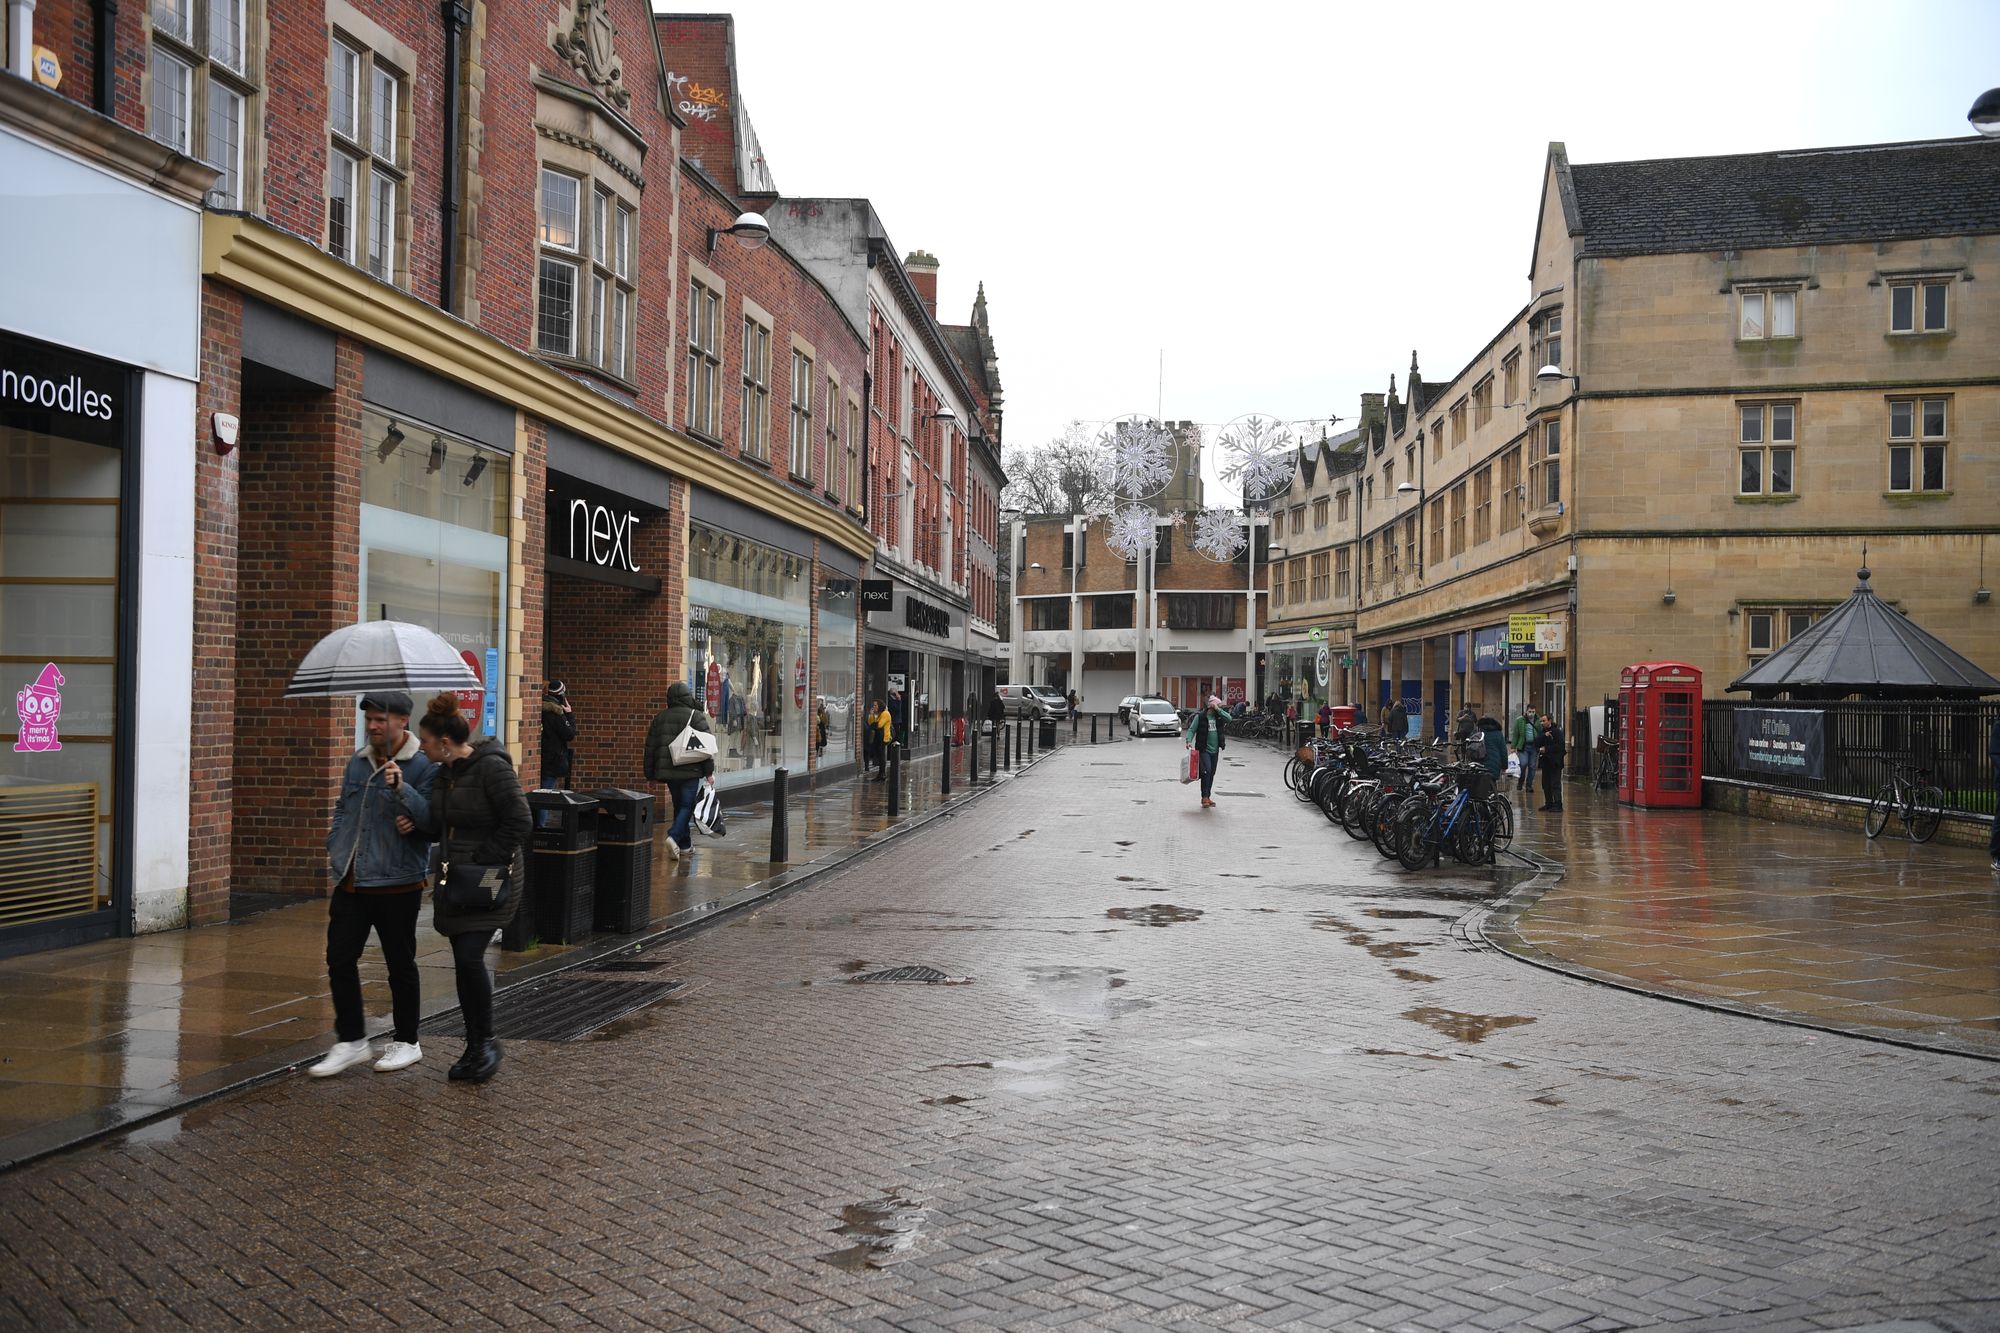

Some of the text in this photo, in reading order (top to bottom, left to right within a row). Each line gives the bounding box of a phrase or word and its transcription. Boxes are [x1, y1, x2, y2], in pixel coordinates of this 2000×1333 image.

[2, 369, 112, 420] noodles
[221, 421, 237, 430] KINGS
[570, 499, 640, 572] next
[863, 591, 889, 600] next
[690, 606, 709, 622] MERRY
[1511, 633, 1535, 641] TO LE
[689, 648, 707, 662] THIN
[1479, 643, 1495, 657] pharmacy
[29, 727, 48, 736] merry
[1771, 719, 1790, 736] Online
